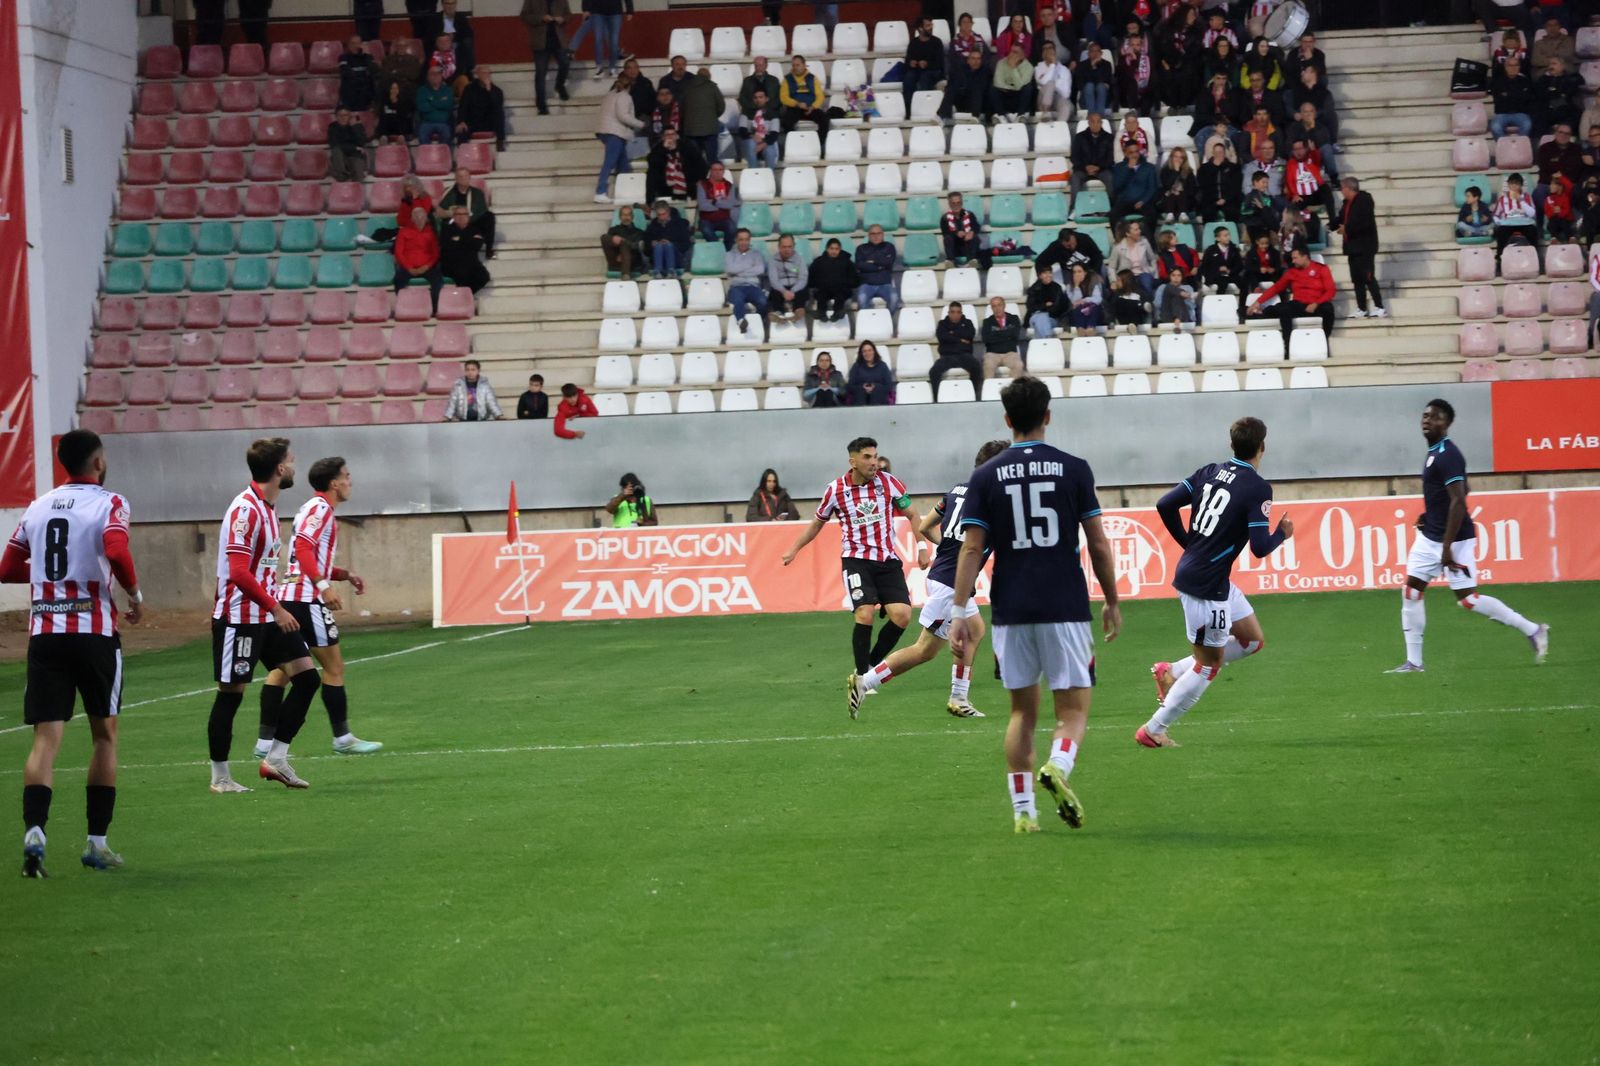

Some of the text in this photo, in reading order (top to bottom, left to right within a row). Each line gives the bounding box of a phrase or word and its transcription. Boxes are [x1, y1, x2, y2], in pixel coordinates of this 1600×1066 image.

[1526, 437, 1553, 450] LA
[996, 461, 1063, 482] IKER ALDAI
[1004, 481, 1060, 550] 15
[1192, 483, 1231, 537] 18
[45, 517, 69, 581] 8
[848, 573, 861, 589] 10
[1257, 574, 1279, 590] El
[1284, 573, 1358, 589] Correo
[1378, 569, 1404, 585] de
[561, 575, 763, 617] ZAMORA
[1210, 609, 1226, 629] 18
[236, 636, 252, 657] 18
